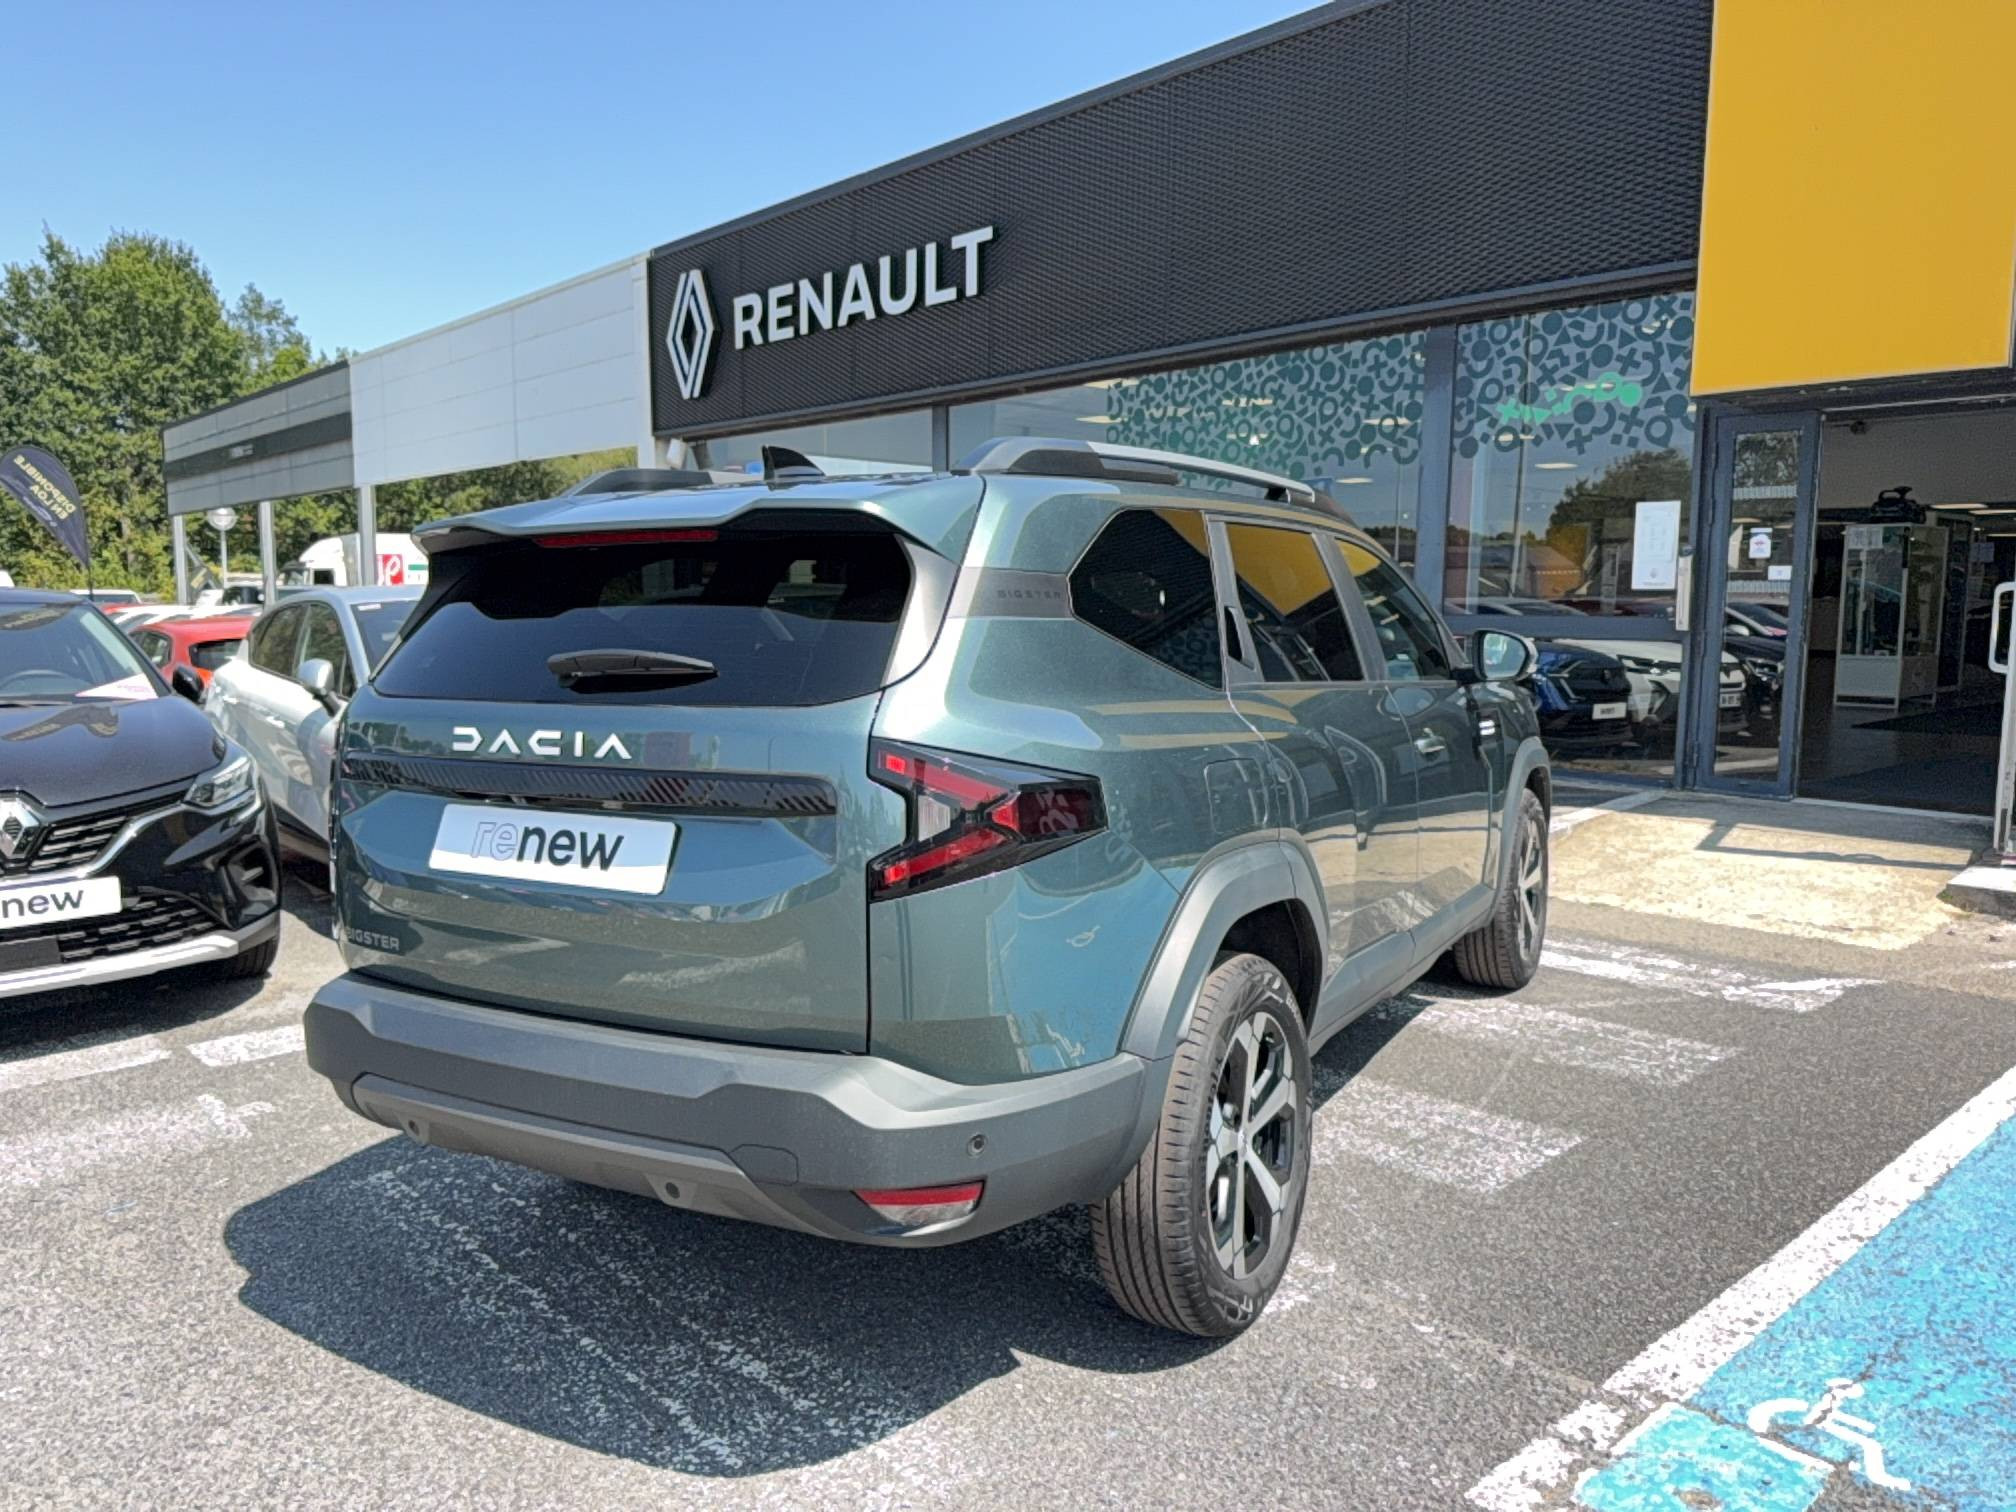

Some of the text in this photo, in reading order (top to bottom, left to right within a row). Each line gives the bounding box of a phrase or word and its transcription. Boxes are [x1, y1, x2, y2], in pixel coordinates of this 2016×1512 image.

[734, 225, 994, 350] RENAULT
[452, 726, 632, 760] DACIA
[469, 821, 624, 872] renew
